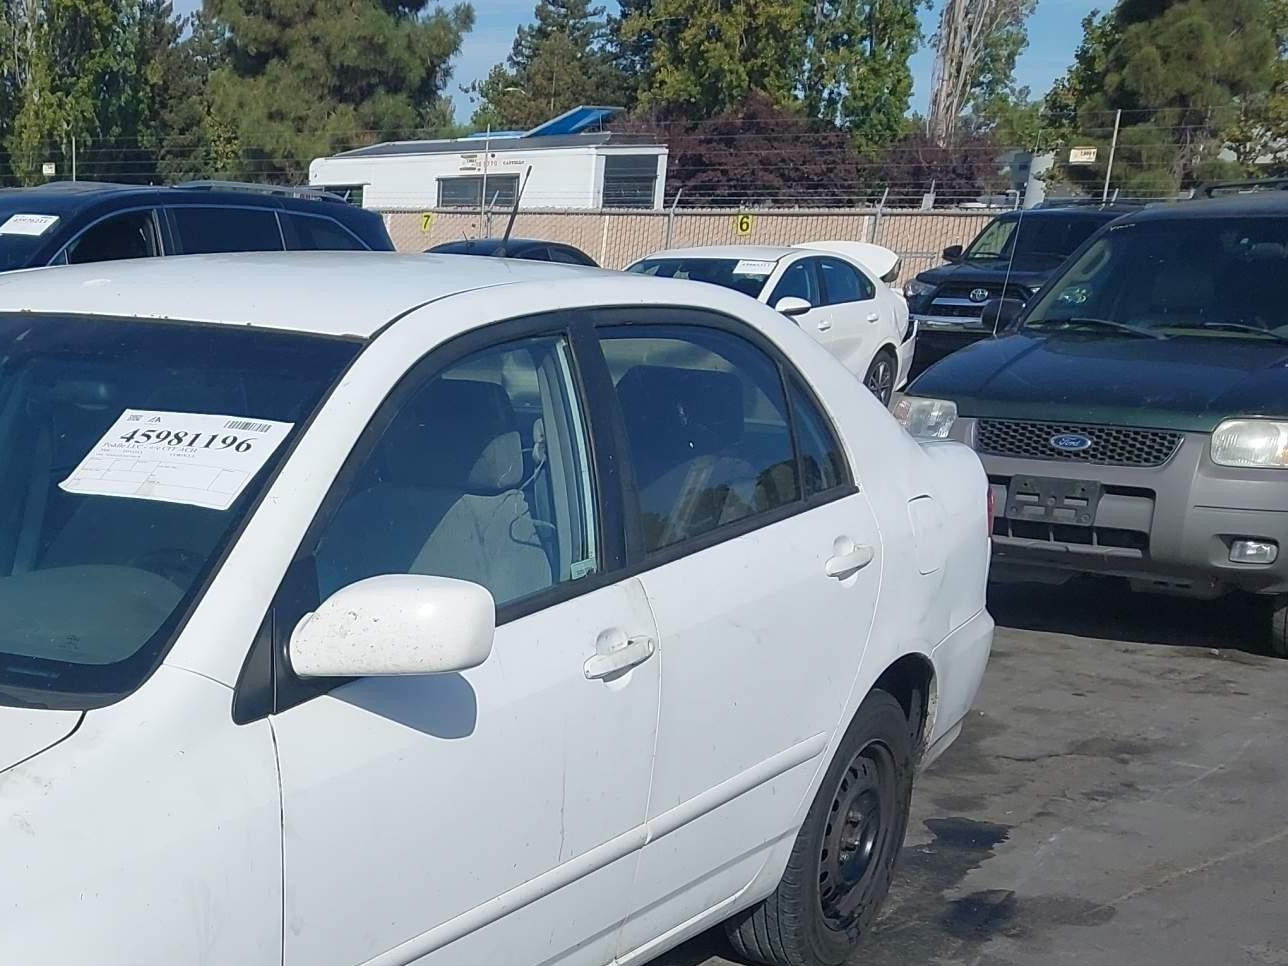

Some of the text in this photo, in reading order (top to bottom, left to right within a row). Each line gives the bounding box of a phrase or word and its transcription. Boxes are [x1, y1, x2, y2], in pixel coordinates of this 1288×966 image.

[423, 214, 431, 230] 7
[739, 215, 750, 232] 6
[120, 427, 257, 453] 45981196
